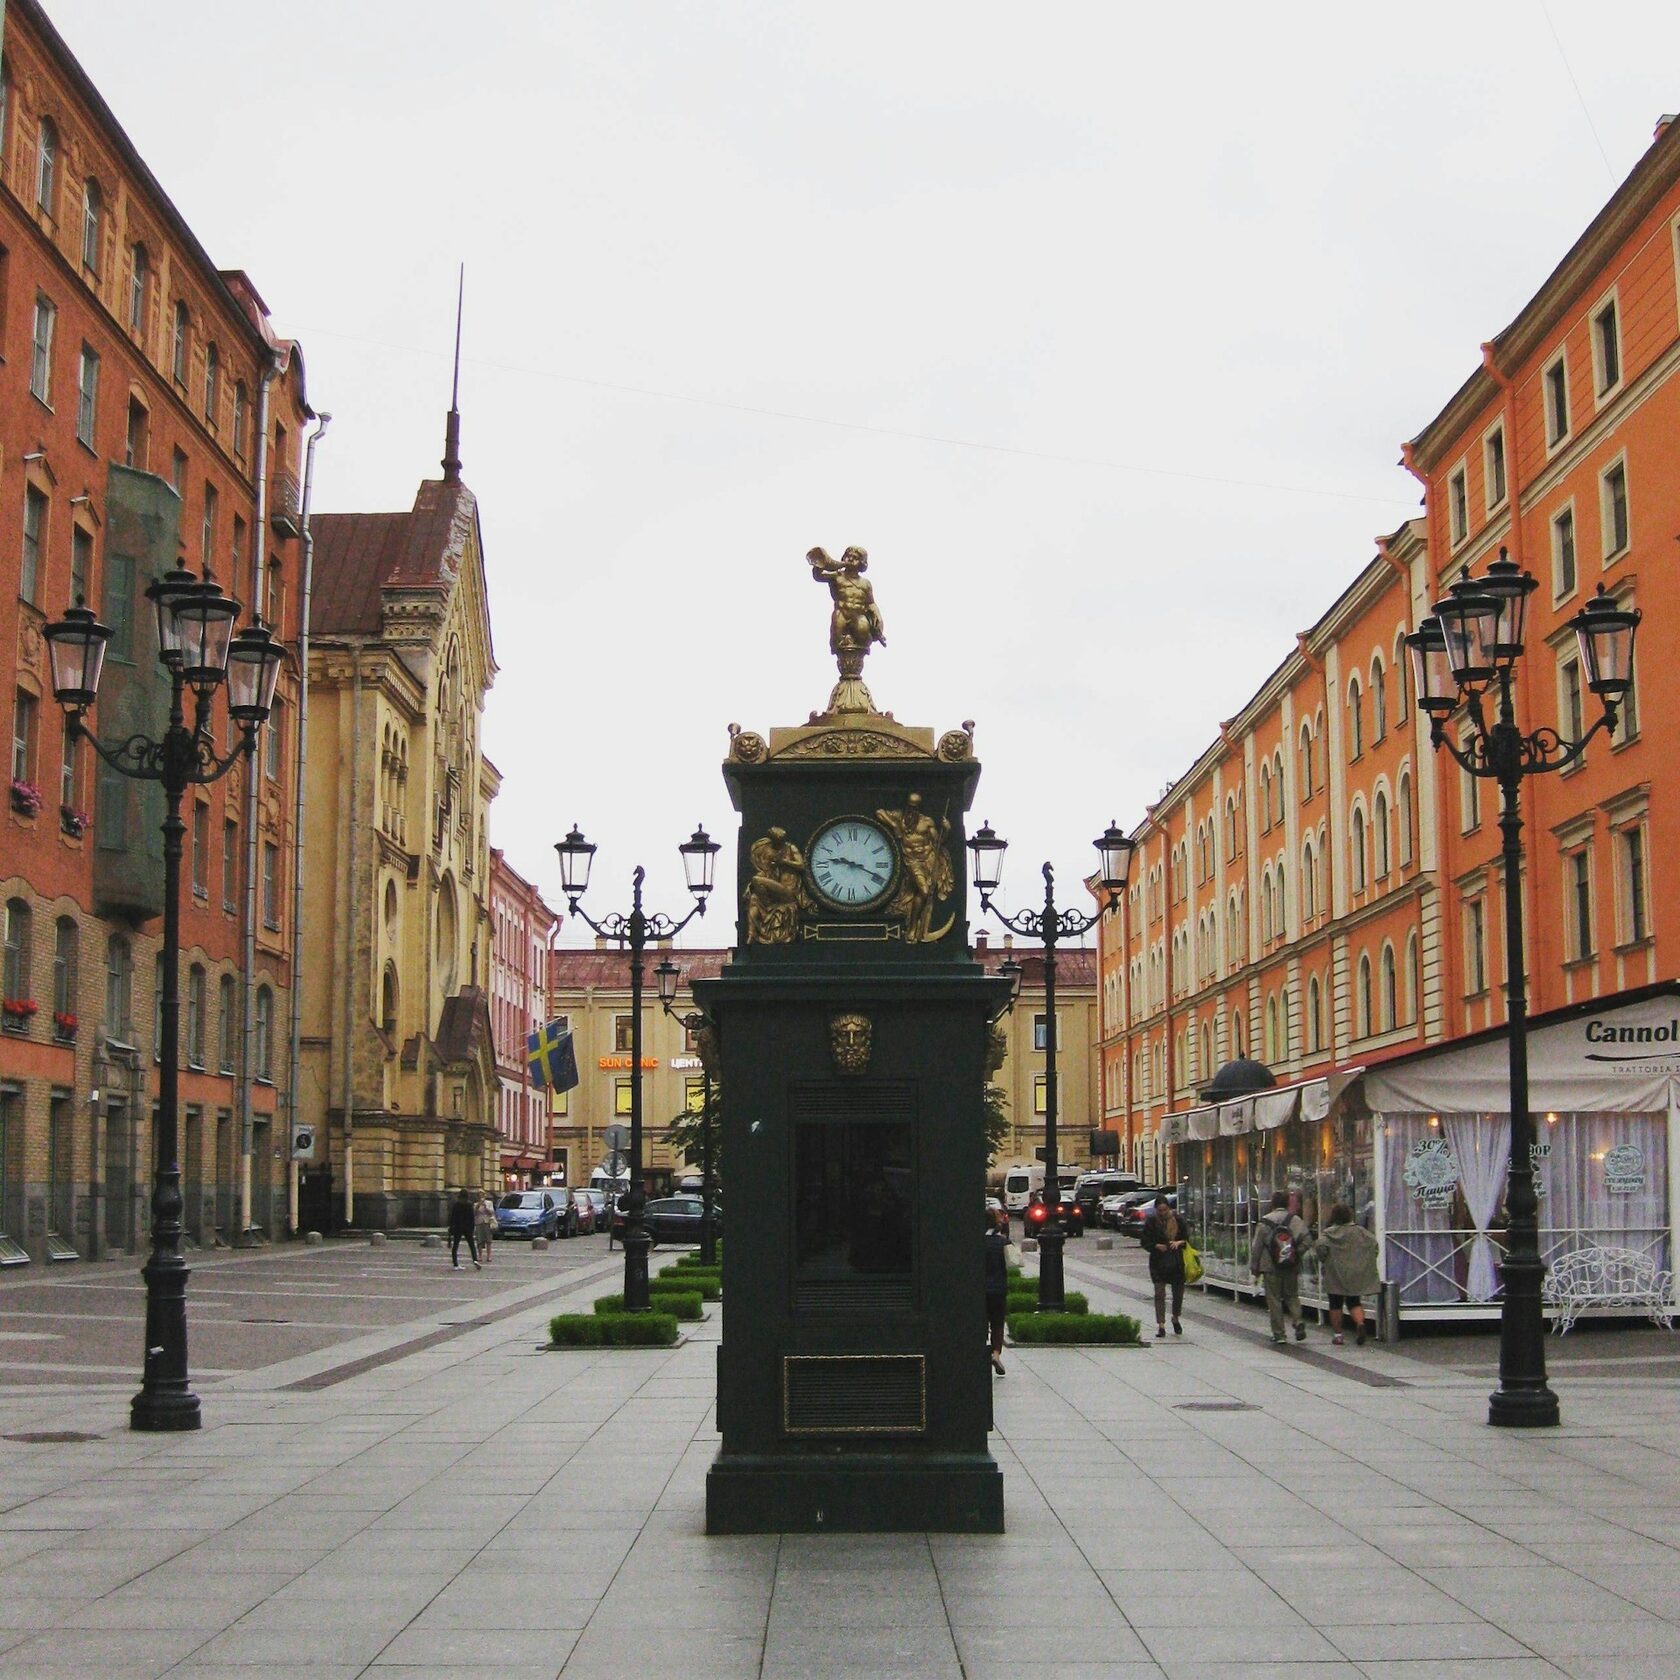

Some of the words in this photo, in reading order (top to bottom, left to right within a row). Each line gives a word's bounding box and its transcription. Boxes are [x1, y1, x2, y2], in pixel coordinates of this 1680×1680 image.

[599, 1058, 622, 1068] SUN
[625, 1058, 659, 1068] CNIC
[1612, 1066, 1672, 1074] TRATTORIA
